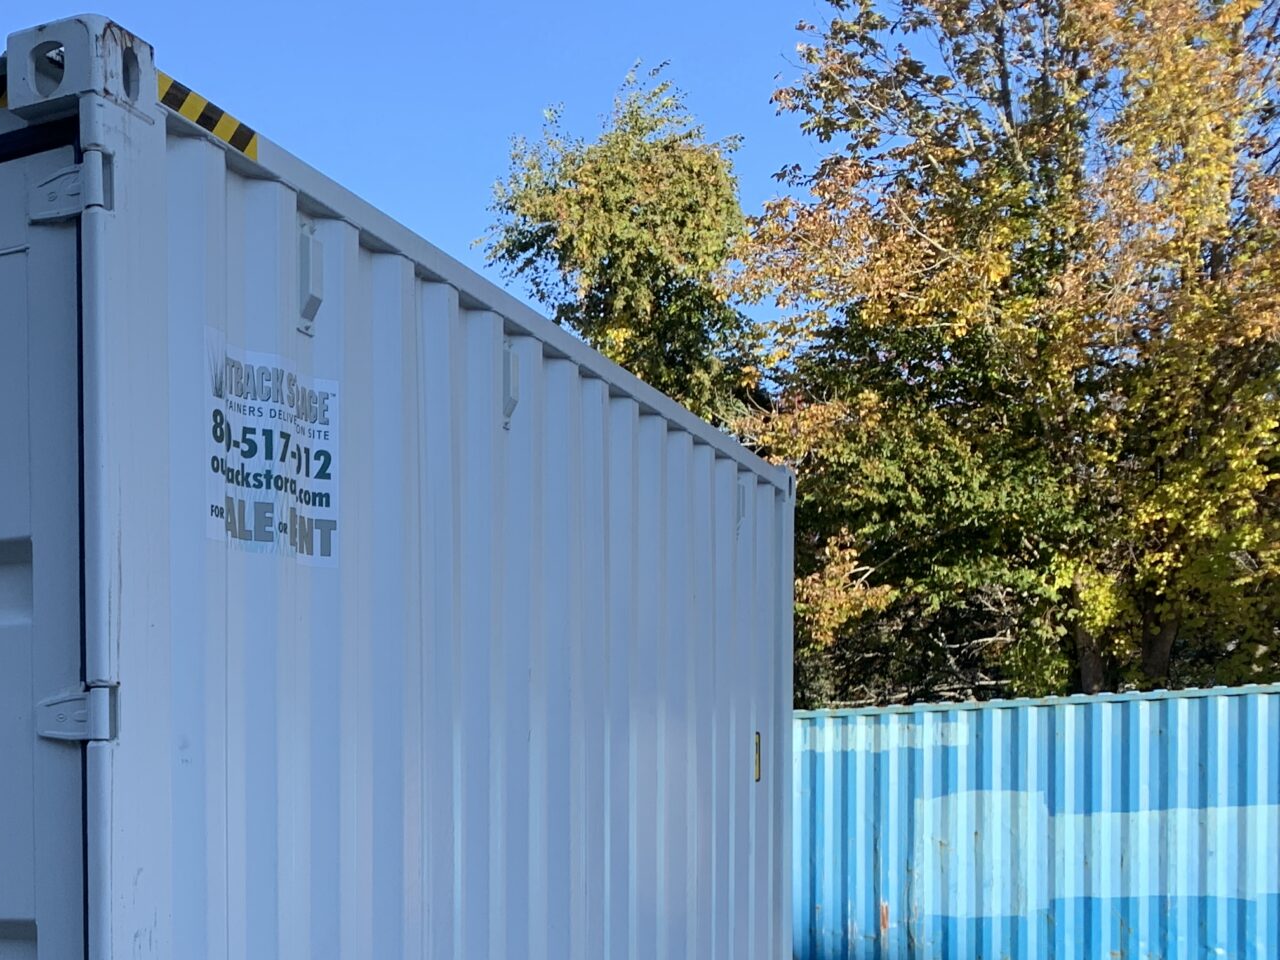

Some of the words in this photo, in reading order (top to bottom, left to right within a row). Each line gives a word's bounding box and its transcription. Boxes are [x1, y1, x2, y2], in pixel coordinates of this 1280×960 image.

[308, 427, 329, 440] SITE
[210, 504, 224, 519] FOR
[225, 496, 274, 542] ALE
[279, 521, 288, 534] OR
